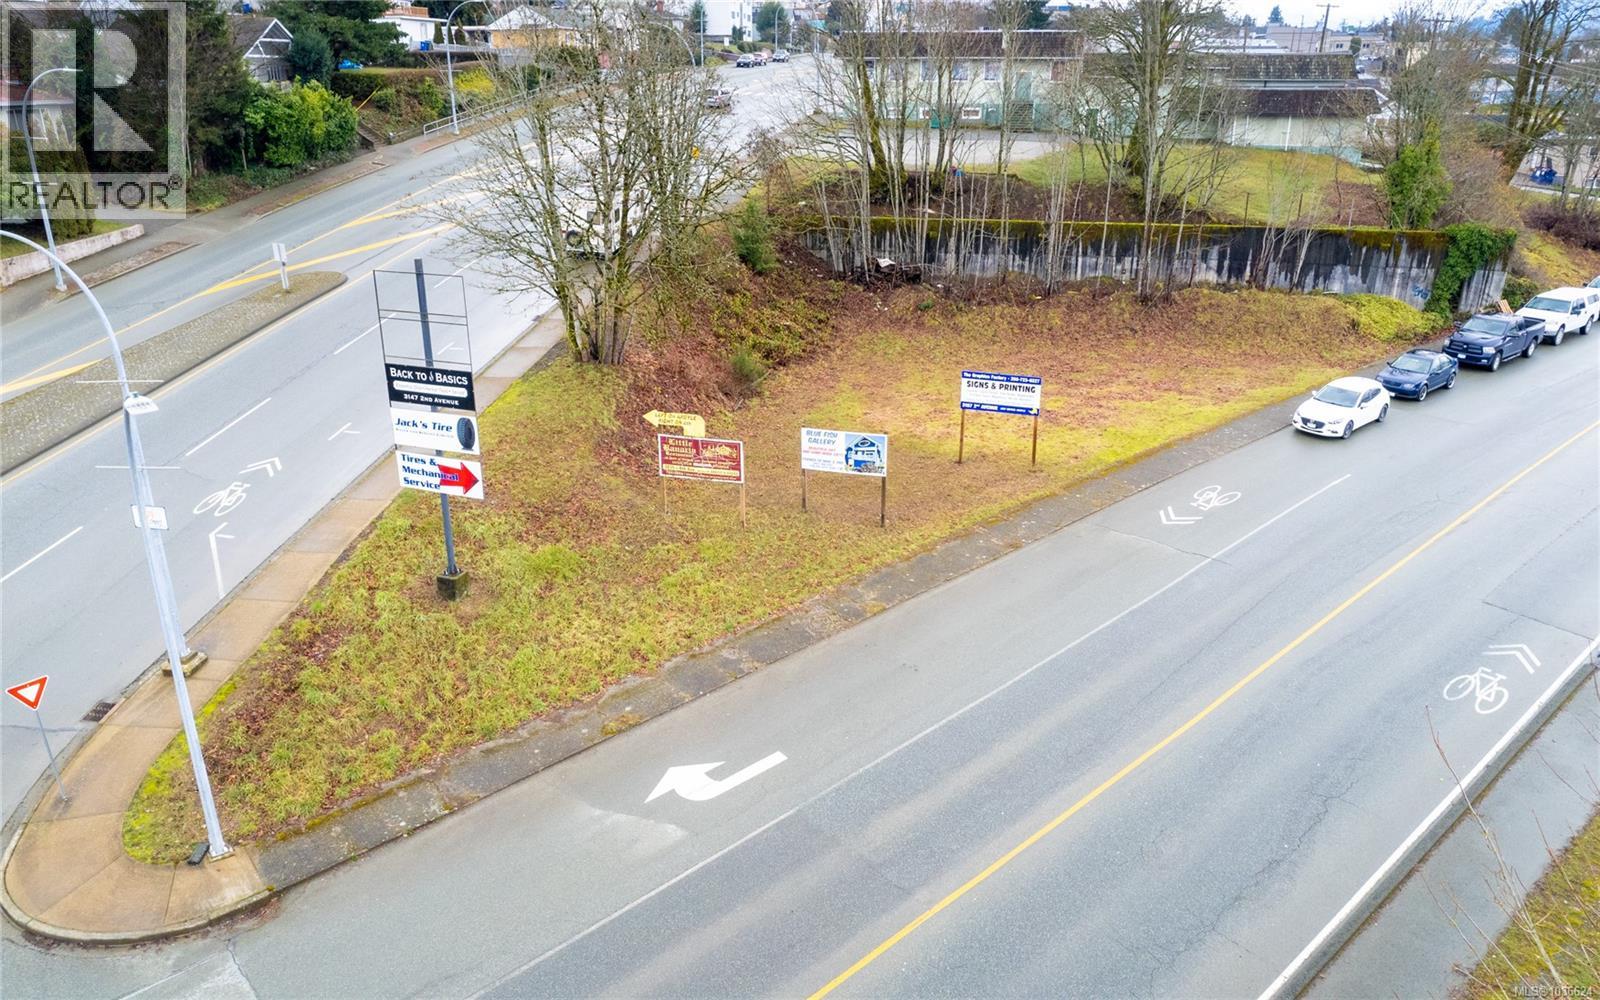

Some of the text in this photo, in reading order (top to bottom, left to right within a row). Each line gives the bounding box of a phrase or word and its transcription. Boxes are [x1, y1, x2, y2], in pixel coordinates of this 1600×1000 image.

[389, 367, 468, 385] BACK TO BASICS
[966, 380, 1037, 393] SIGNS & PRINTING
[434, 397, 460, 405] AVENUE
[394, 417, 453, 432] Jack's Tire
[806, 429, 821, 437] BLUE
[807, 437, 836, 445] GALLERY
[400, 453, 438, 466] Tires &
[402, 465, 459, 481] Mechanical
[403, 477, 441, 490] Service
